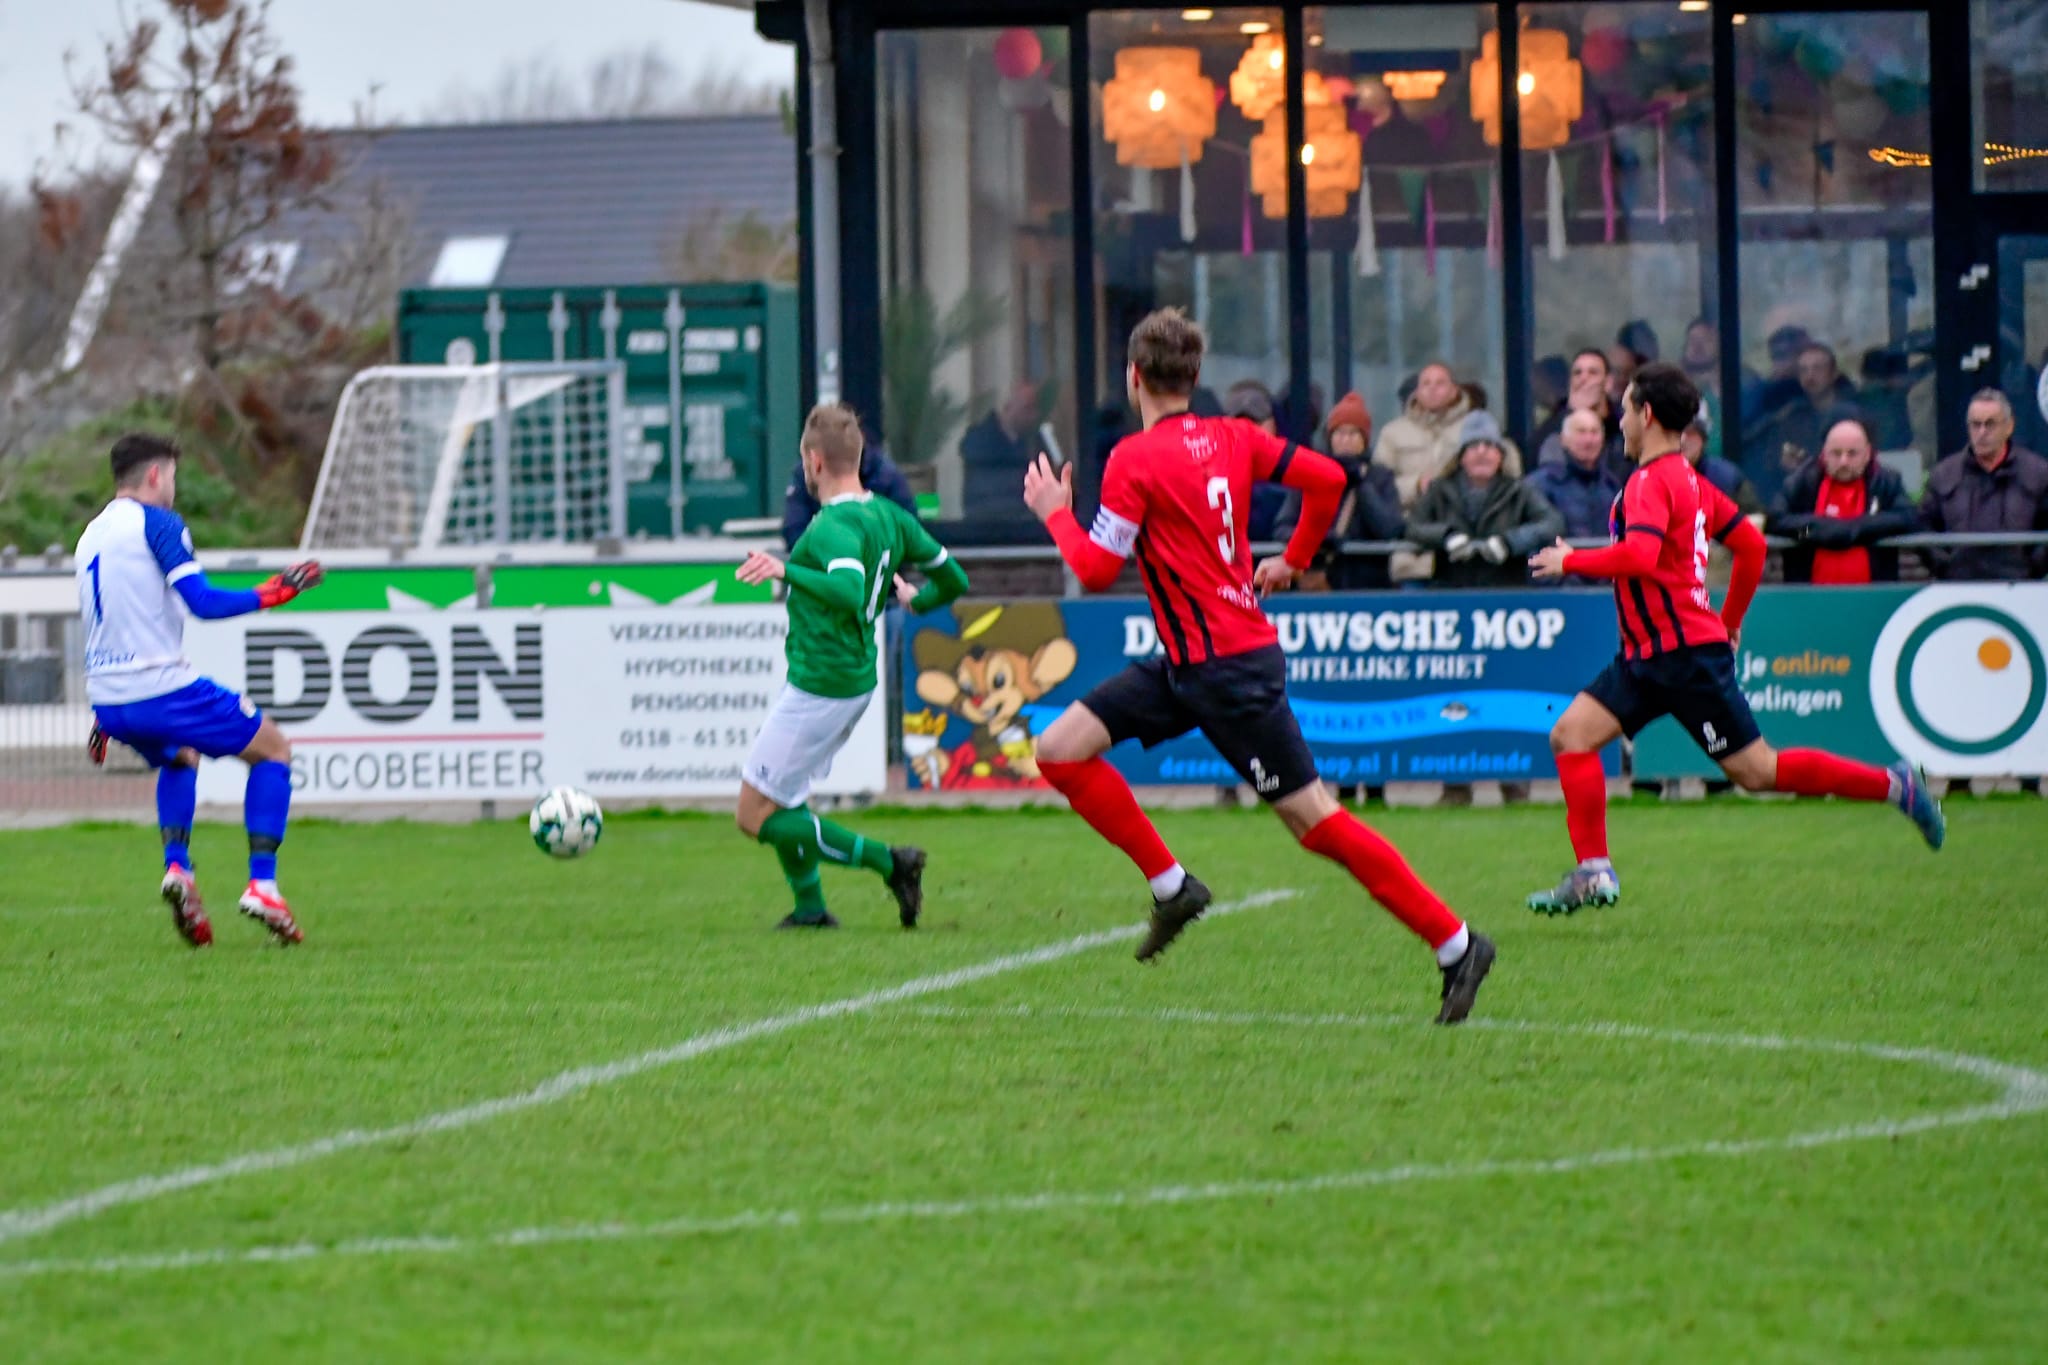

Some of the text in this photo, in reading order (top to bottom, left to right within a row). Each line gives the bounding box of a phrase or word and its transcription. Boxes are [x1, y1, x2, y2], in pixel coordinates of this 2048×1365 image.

[1206, 476, 1235, 565] 3
[86, 551, 103, 627] 1
[610, 621, 787, 643] VERZEKERINGEN
[1267, 610, 1462, 653] UWSCHE
[1472, 608, 1566, 650] MOP
[244, 624, 544, 724] DON
[624, 655, 774, 677] HYPOTHEKEN
[1286, 652, 1488, 682] HTELIJKE FRIET
[1741, 649, 1851, 683] je online
[630, 692, 769, 713] PENSIOENEN
[1744, 684, 1843, 717] elingen
[620, 727, 672, 748] 0118
[694, 727, 717, 748] 61
[290, 749, 544, 791] SICOBEHEER
[1410, 748, 1532, 774] zoutelande
